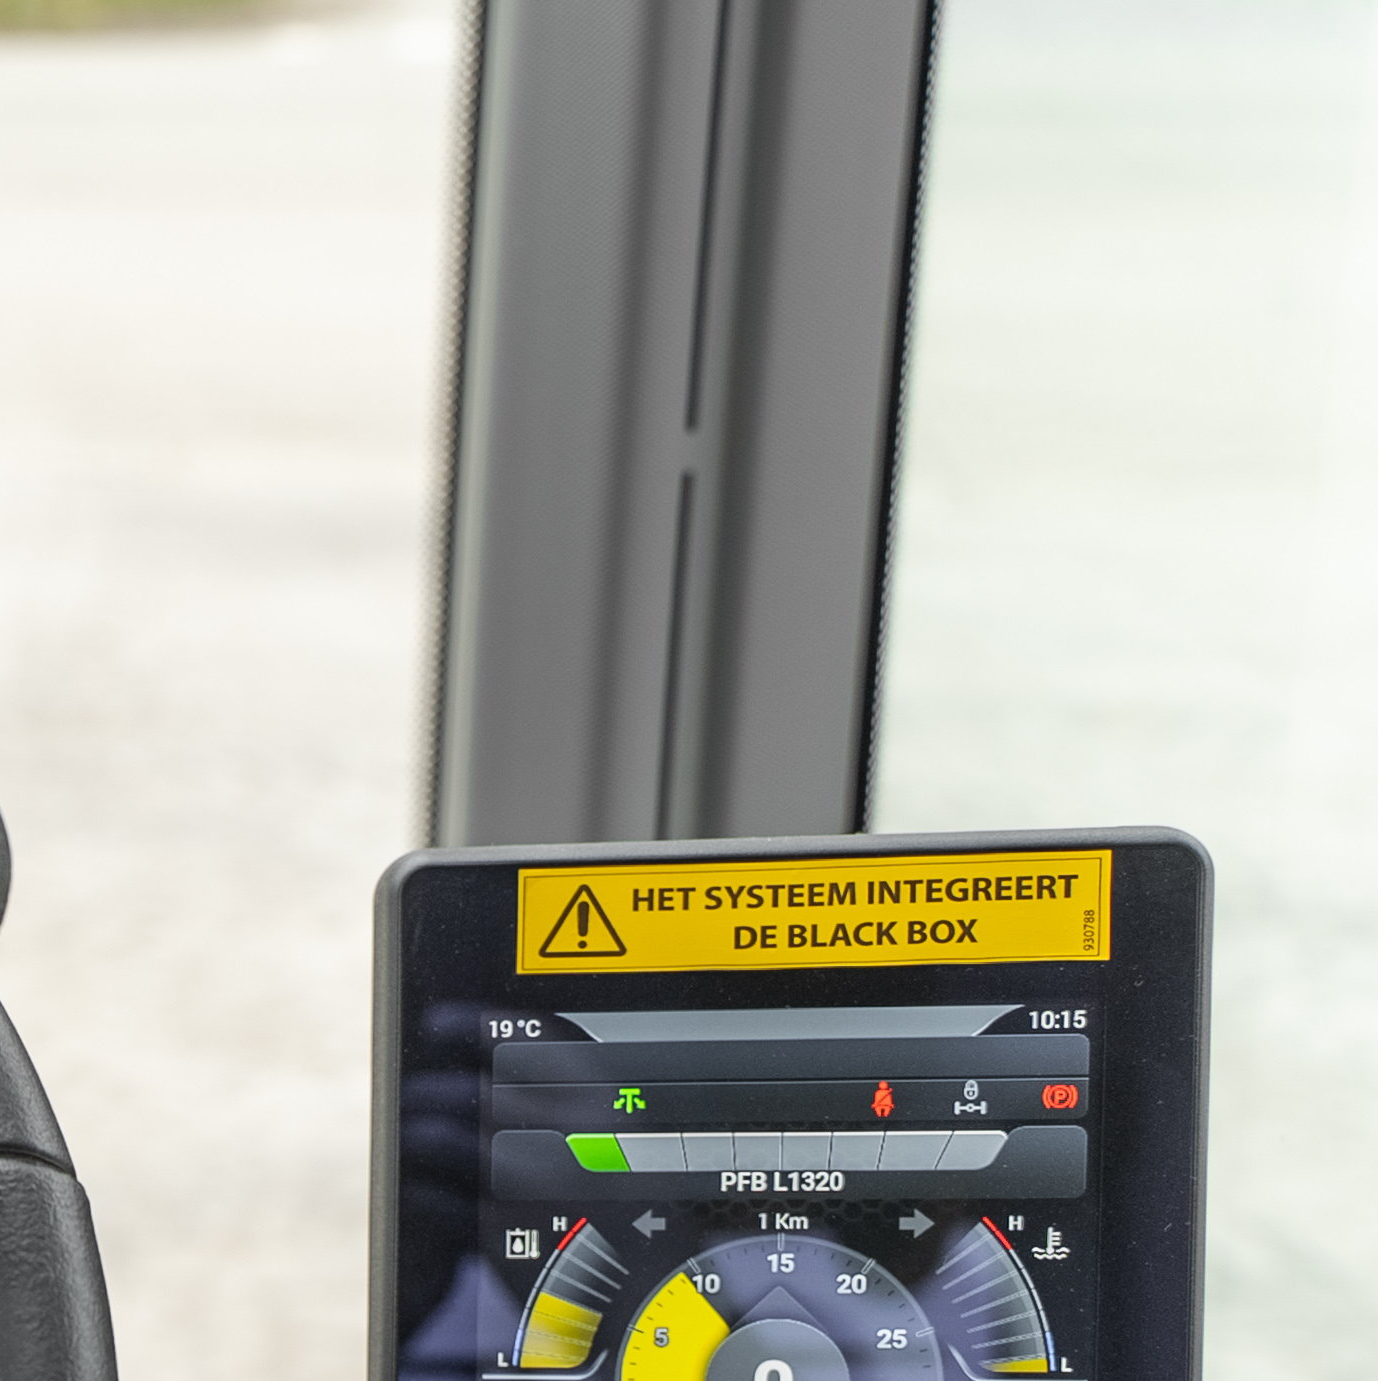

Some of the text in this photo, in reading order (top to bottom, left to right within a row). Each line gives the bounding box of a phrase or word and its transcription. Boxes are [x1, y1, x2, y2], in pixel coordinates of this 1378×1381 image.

[631, 874, 1079, 912] HET SYSTEEM INTEGREERT
[733, 919, 979, 950] DE BLACK BOX
[1083, 909, 1095, 951] 930788
[1028, 1009, 1088, 1031] 10:15
[720, 1172, 845, 1193] PFB L1320
[552, 1216, 568, 1232] H
[757, 1212, 809, 1231] 1 Km
[1008, 1215, 1024, 1231] H
[766, 1253, 795, 1273] 15
[693, 1274, 721, 1295] 10
[836, 1273, 868, 1295] 20
[654, 1328, 669, 1348] 5
[876, 1328, 908, 1350] 25
[497, 1352, 509, 1368] L
[1060, 1357, 1073, 1373] L
